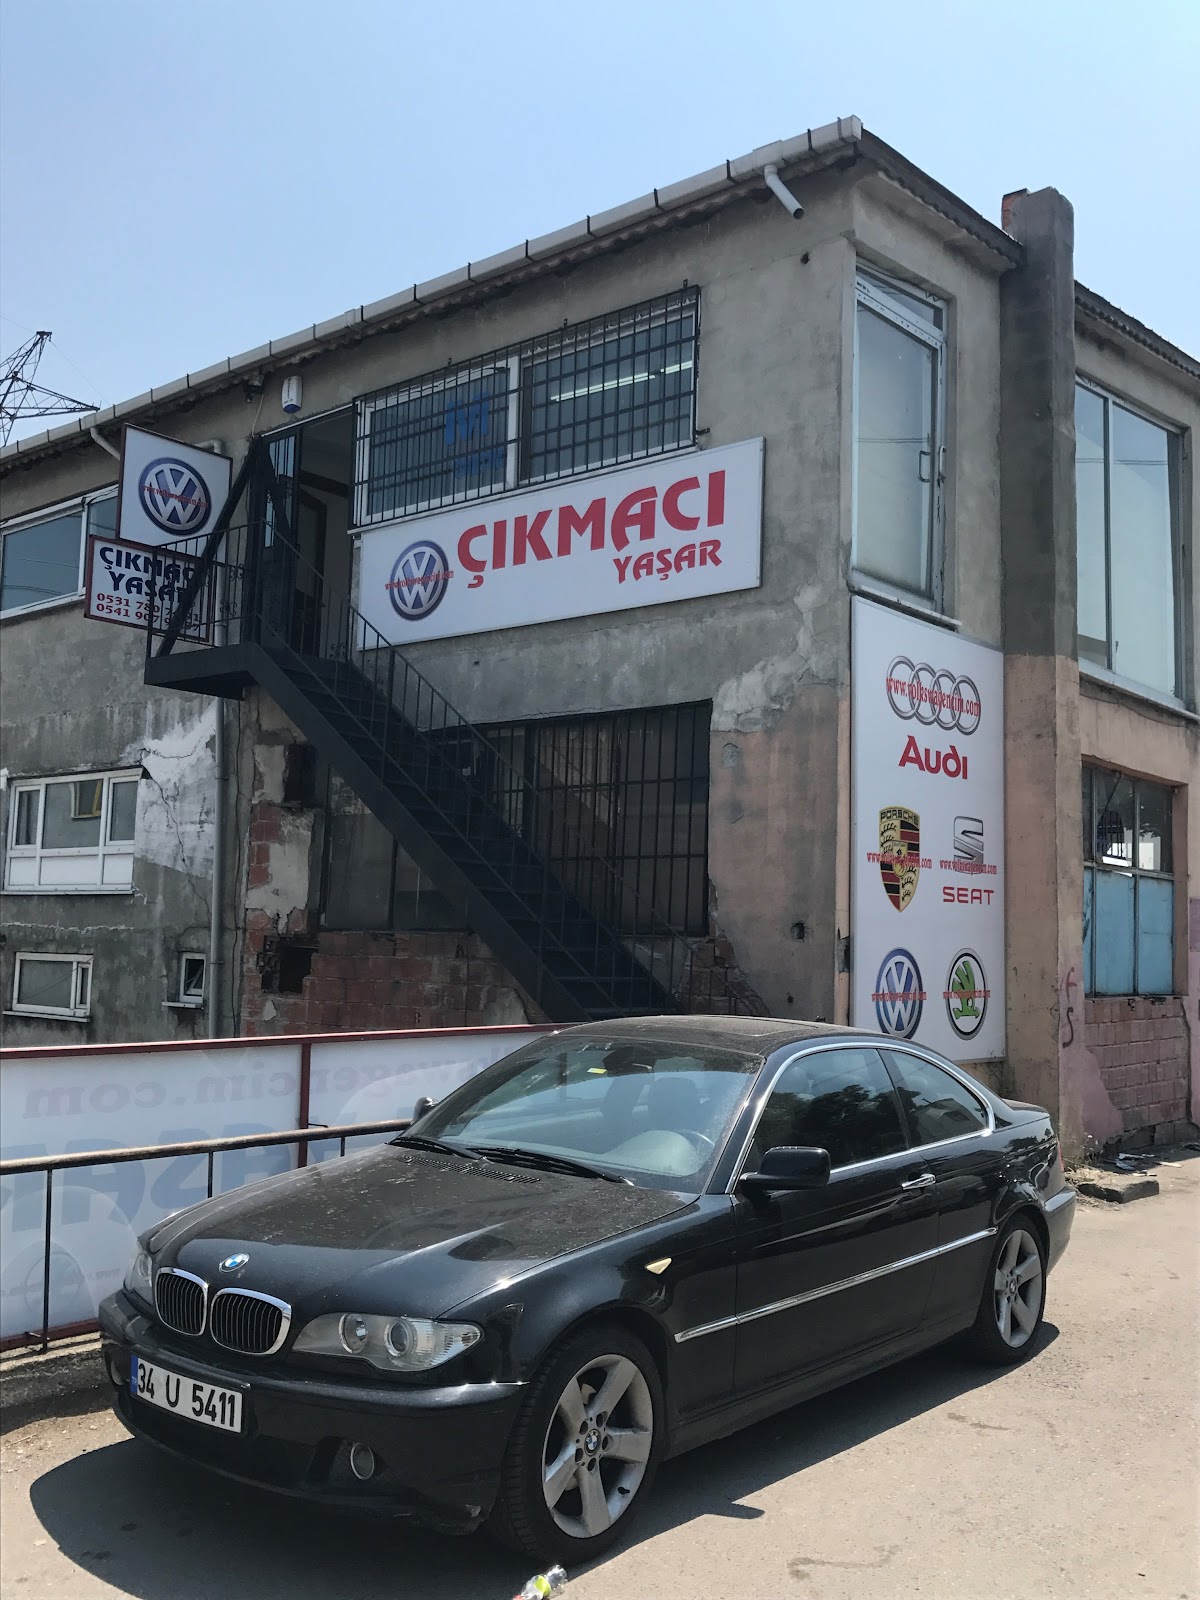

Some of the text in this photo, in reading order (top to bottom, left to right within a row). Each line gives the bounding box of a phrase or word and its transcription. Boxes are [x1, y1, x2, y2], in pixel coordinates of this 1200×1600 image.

[457, 470, 726, 589] ÇIKMACI
[99, 546, 200, 584] ÇIKMAC
[613, 539, 722, 584] YAŞAR
[96, 603, 131, 618] 0541
[97, 593, 131, 607] 0531
[898, 734, 969, 780] Audi
[880, 808, 920, 828] PORSCHE
[942, 886, 995, 905] SEAT
[138, 1363, 236, 1428] 34 U 5411
